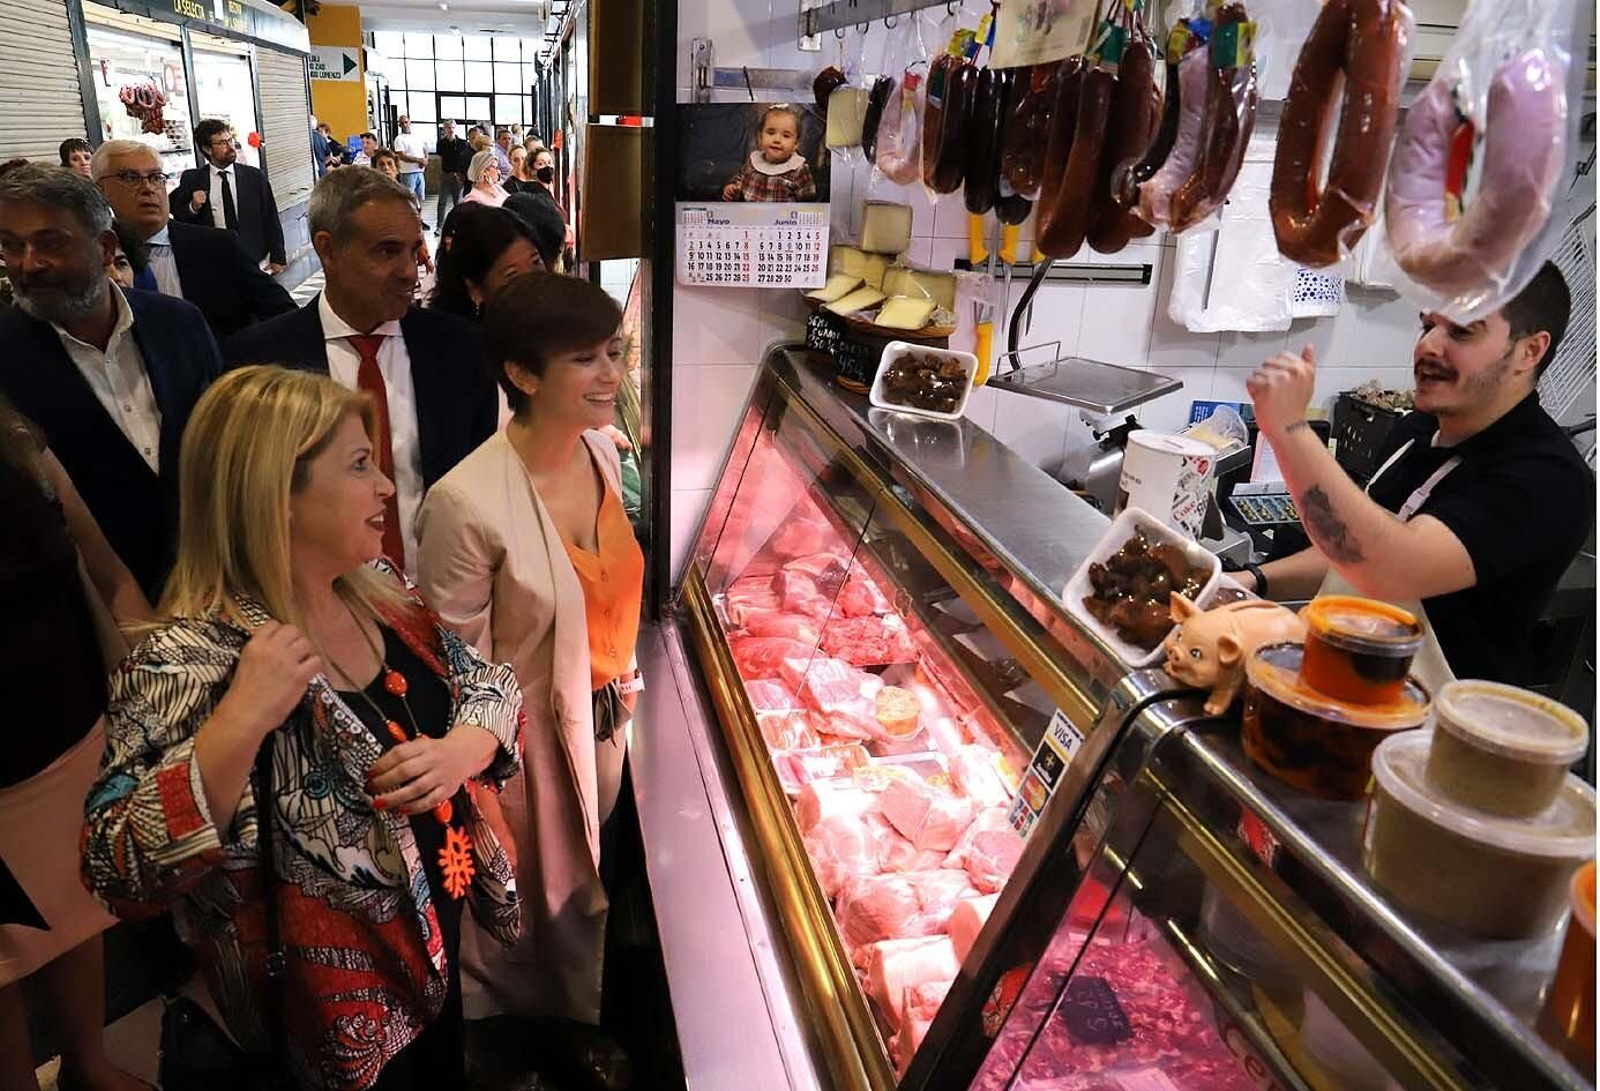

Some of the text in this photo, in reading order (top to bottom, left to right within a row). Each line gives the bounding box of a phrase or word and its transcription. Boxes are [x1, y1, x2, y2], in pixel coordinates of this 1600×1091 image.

[697, 252, 704, 260] 10
[706, 252, 712, 260] 11
[716, 252, 722, 260] 12
[724, 252, 731, 260] 13
[733, 252, 740, 260] 14
[688, 262, 750, 271] 16 17 18 19 20 21 22
[758, 264, 766, 272] 20
[768, 264, 774, 272] 21
[776, 264, 783, 272] 22
[794, 264, 802, 272] 24
[803, 264, 810, 272] 25
[1173, 500, 1196, 522] Coke
[1054, 724, 1072, 750] VISA
